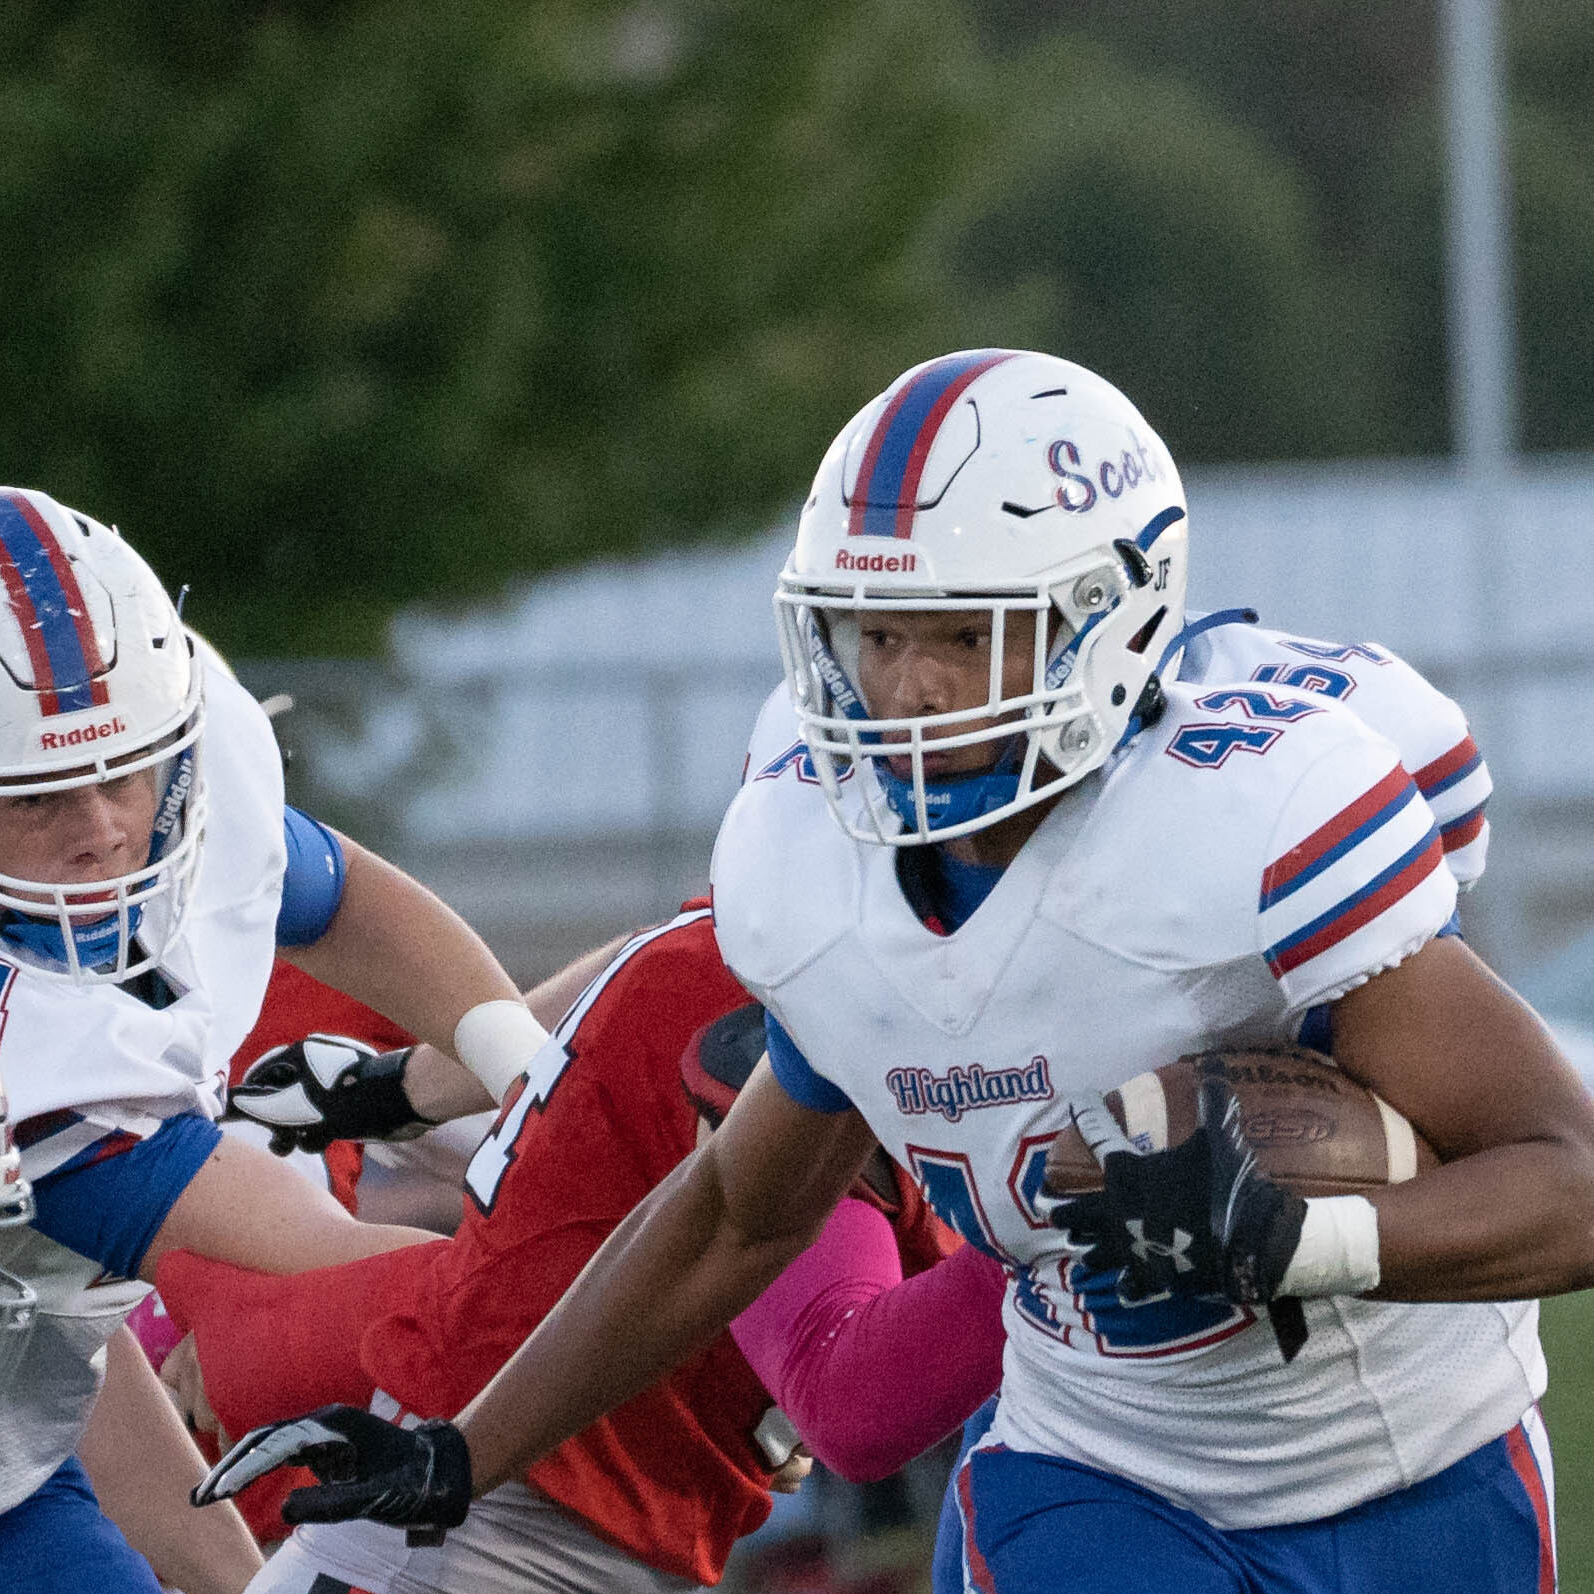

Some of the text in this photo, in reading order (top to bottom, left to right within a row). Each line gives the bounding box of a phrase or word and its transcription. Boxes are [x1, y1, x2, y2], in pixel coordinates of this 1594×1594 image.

[1047, 438, 1163, 514] Scot
[835, 549, 917, 573] Riddell
[1154, 556, 1172, 592] JF
[1164, 688, 1331, 770] 42
[886, 1055, 1055, 1122] Highland
